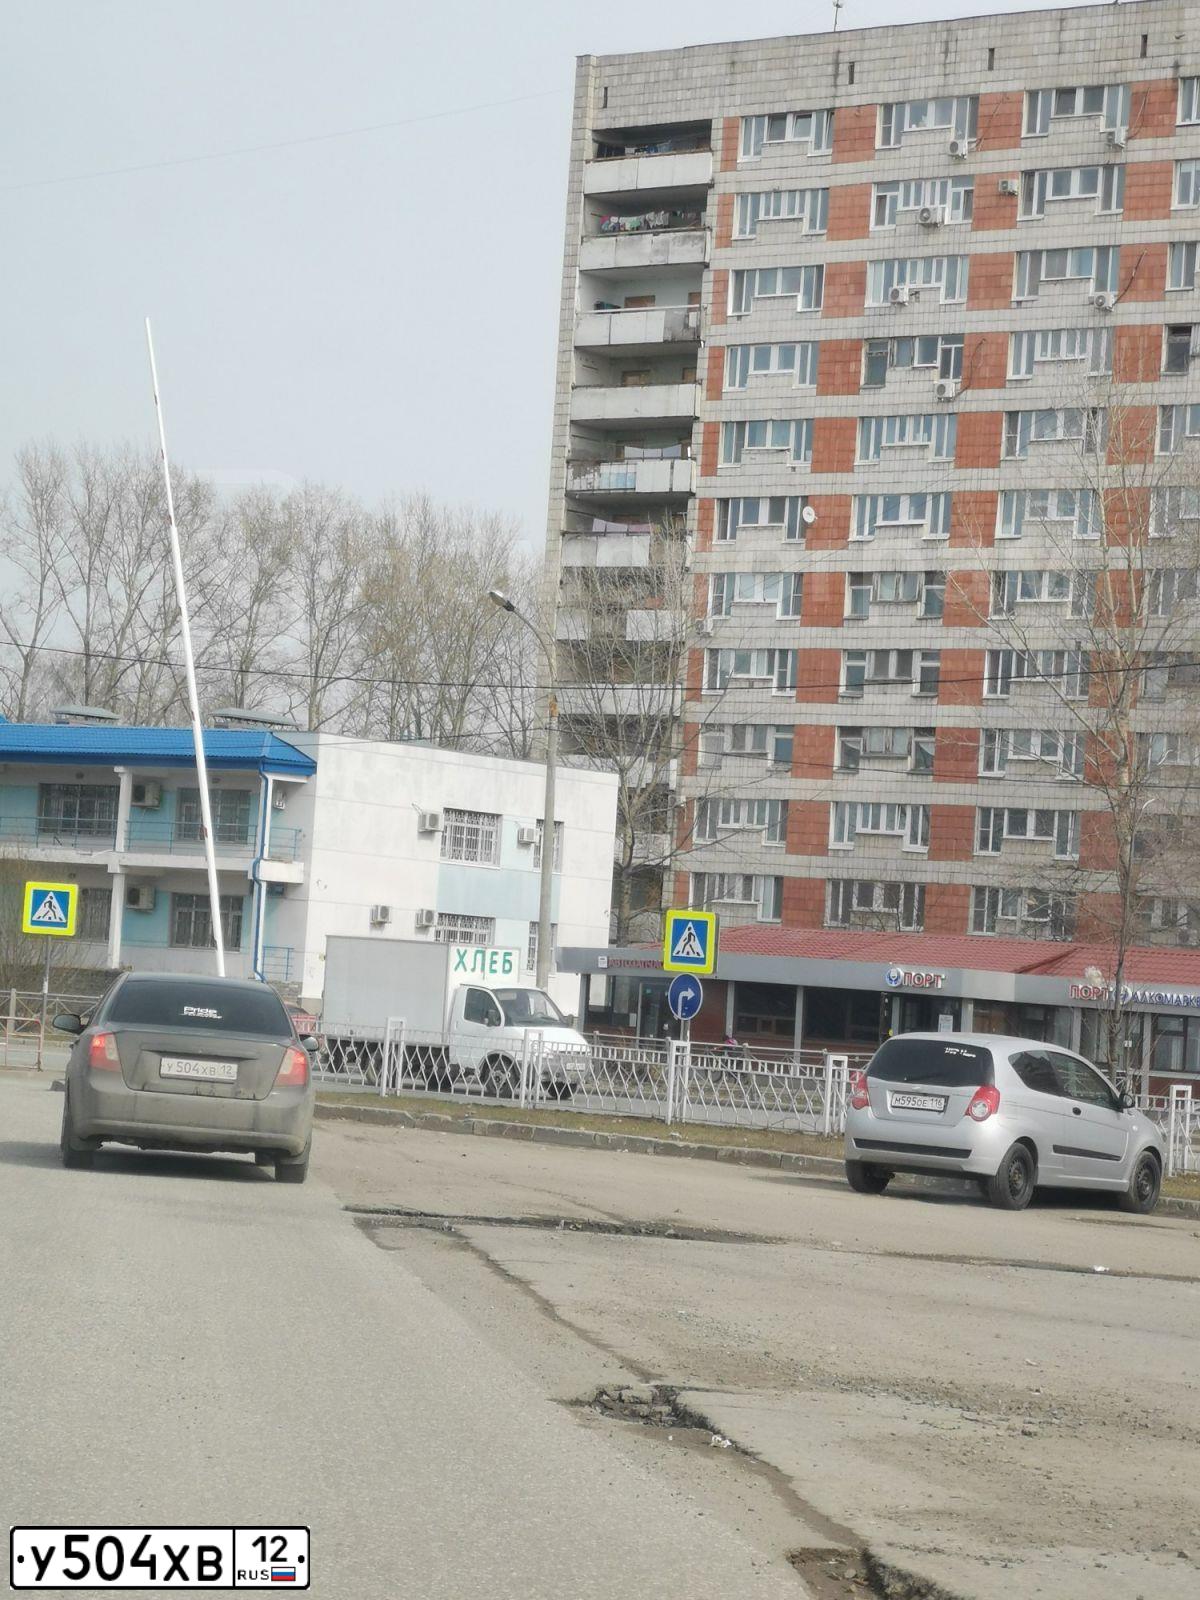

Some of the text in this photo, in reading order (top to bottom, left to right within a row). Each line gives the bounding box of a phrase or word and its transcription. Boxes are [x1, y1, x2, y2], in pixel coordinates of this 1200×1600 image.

[454, 947, 513, 975] ХЛЕБ
[903, 971, 942, 989] ПОРТ
[1069, 984, 1109, 1002] ПОРТ
